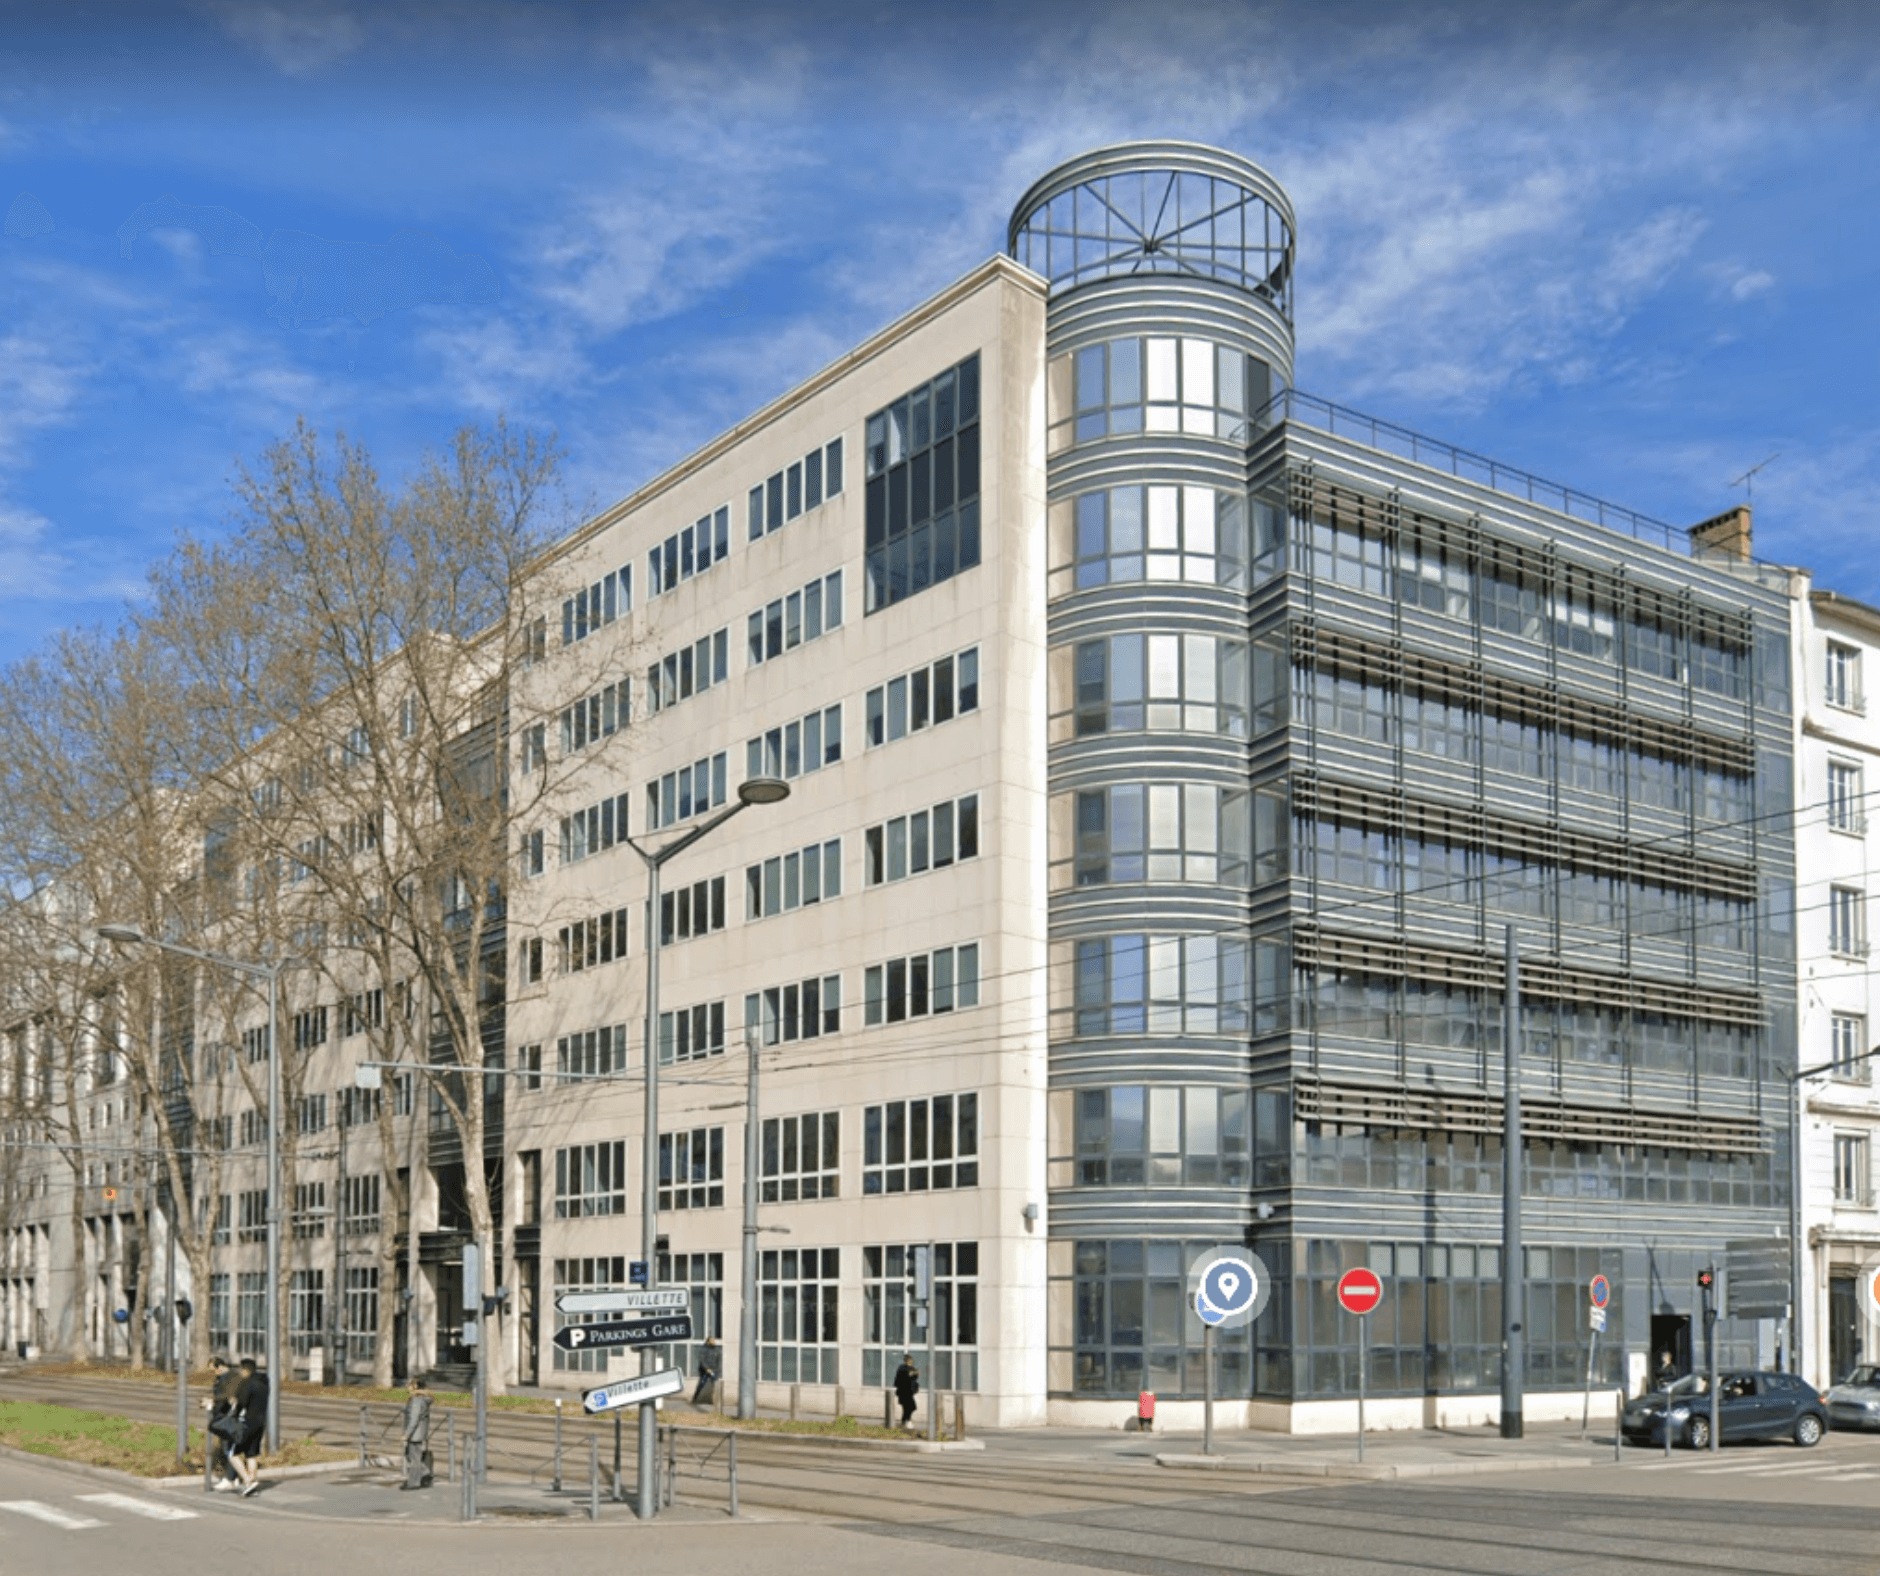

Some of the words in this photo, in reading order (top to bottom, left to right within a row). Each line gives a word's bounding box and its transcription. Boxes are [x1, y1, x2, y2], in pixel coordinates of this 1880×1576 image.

[627, 1293, 682, 1305] VILLETTE
[570, 1328, 586, 1347] P
[607, 1380, 649, 1397] Villette
